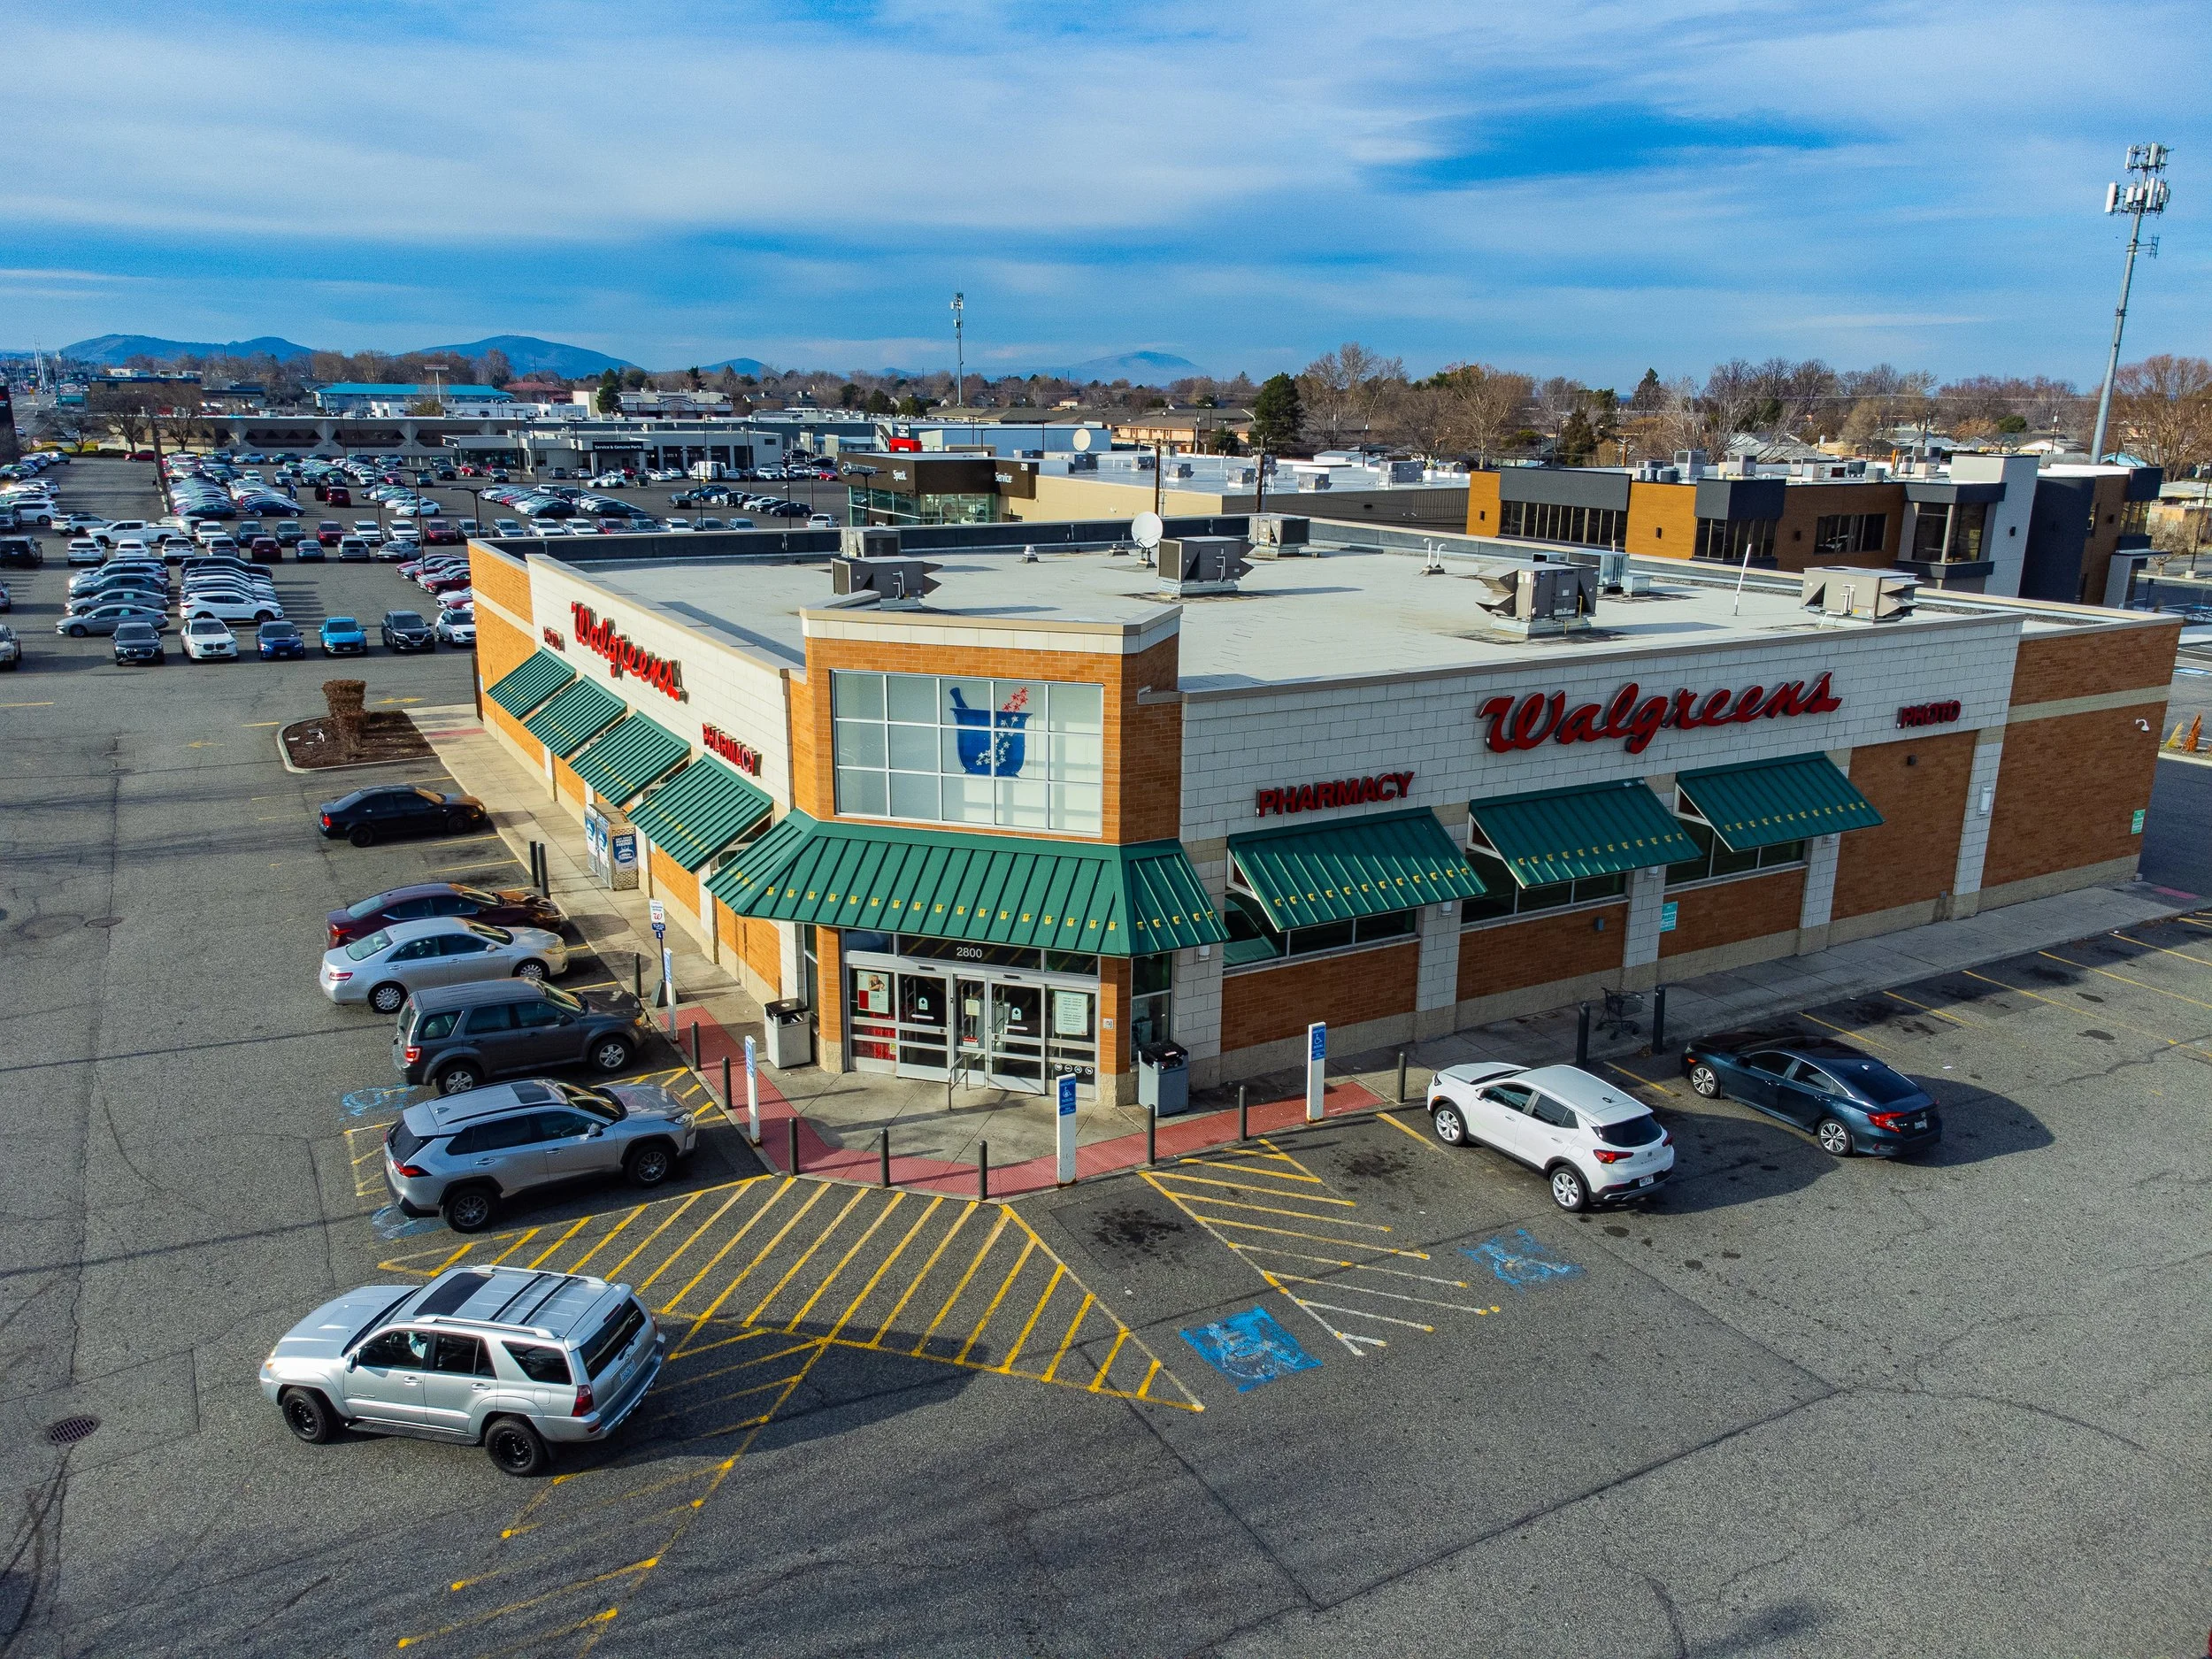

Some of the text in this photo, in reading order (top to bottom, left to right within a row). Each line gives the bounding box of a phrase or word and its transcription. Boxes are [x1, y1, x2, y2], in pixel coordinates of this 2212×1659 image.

[995, 472, 1013, 483] Service
[572, 601, 687, 703] Walgreens
[1478, 672, 1842, 754] Walgreens
[1897, 700, 1962, 729] PHOTO
[703, 722, 760, 777] PHARMACY
[1257, 771, 1416, 817] PHARMACY
[956, 947, 983, 958] 2800
